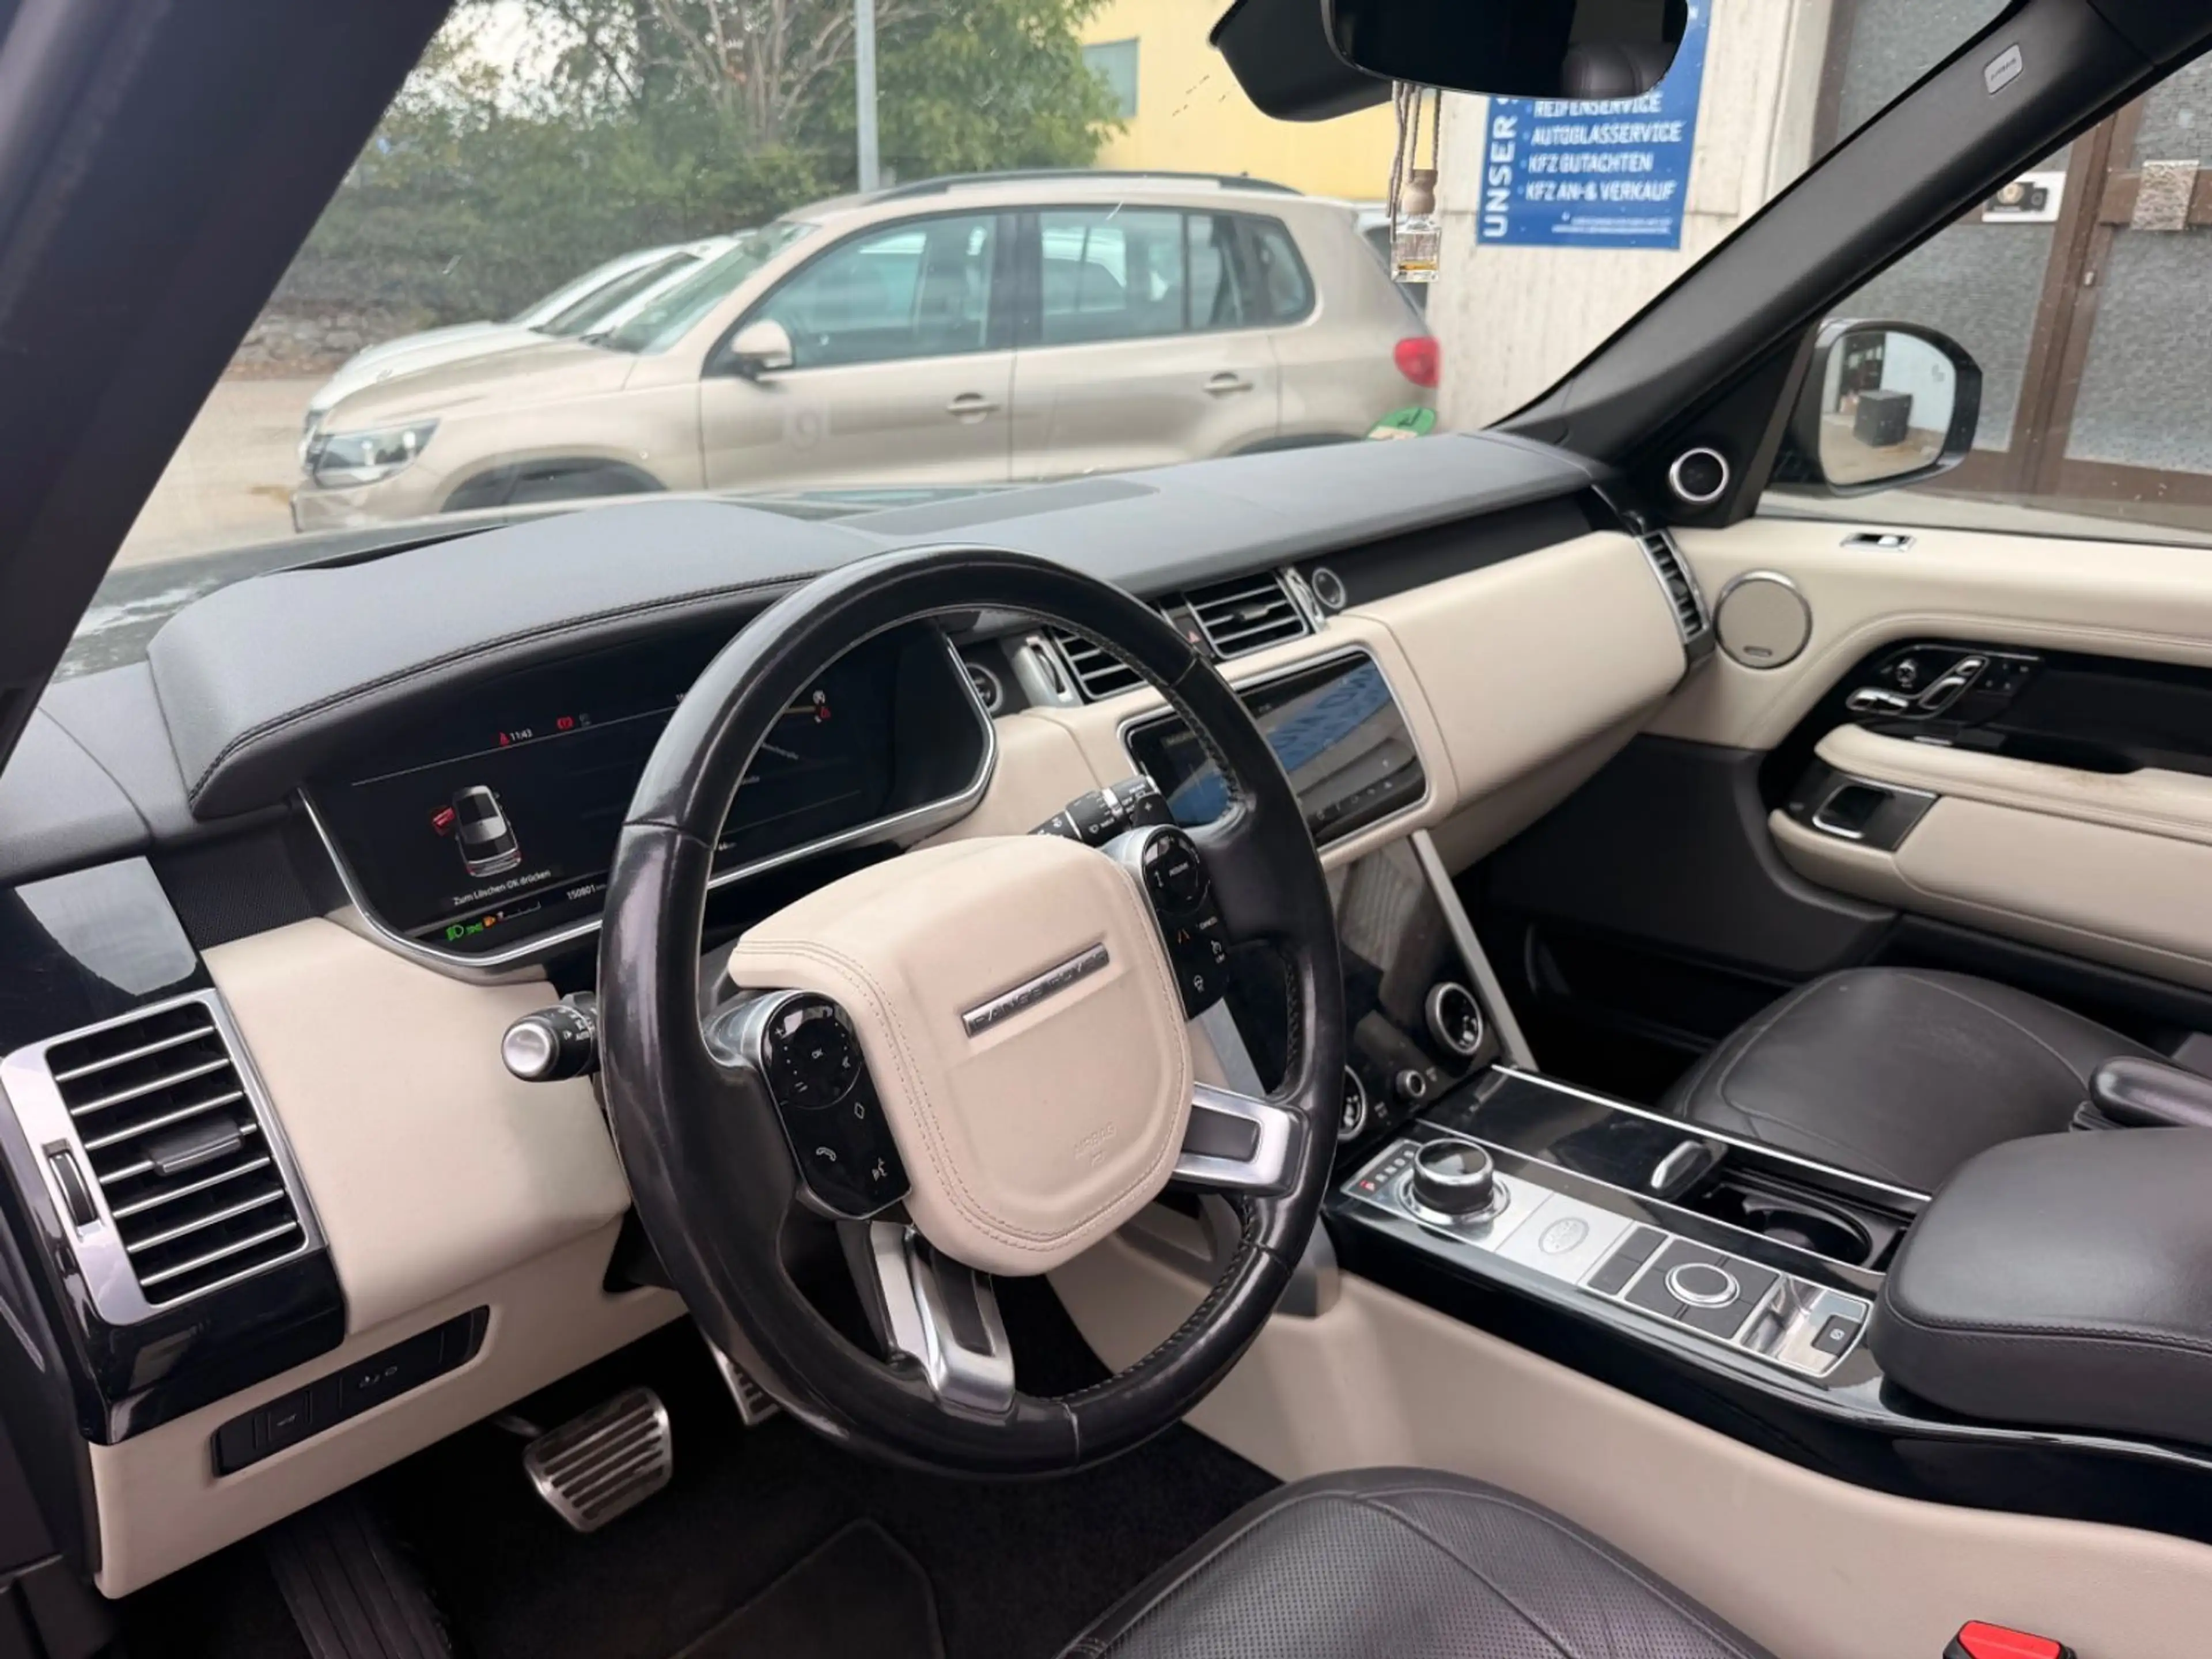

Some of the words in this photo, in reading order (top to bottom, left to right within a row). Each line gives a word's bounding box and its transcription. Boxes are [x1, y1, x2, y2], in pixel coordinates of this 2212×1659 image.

[1531, 120, 1683, 145] AUTOGLASSERVICE
[1528, 153, 1558, 173] KFZ
[1559, 150, 1654, 172] GUTACHTEN
[1483, 115, 1518, 237] UNSER
[1525, 181, 1556, 200] KFZ
[1600, 180, 1675, 200] VERKAUF
[453, 893, 474, 906] Zum
